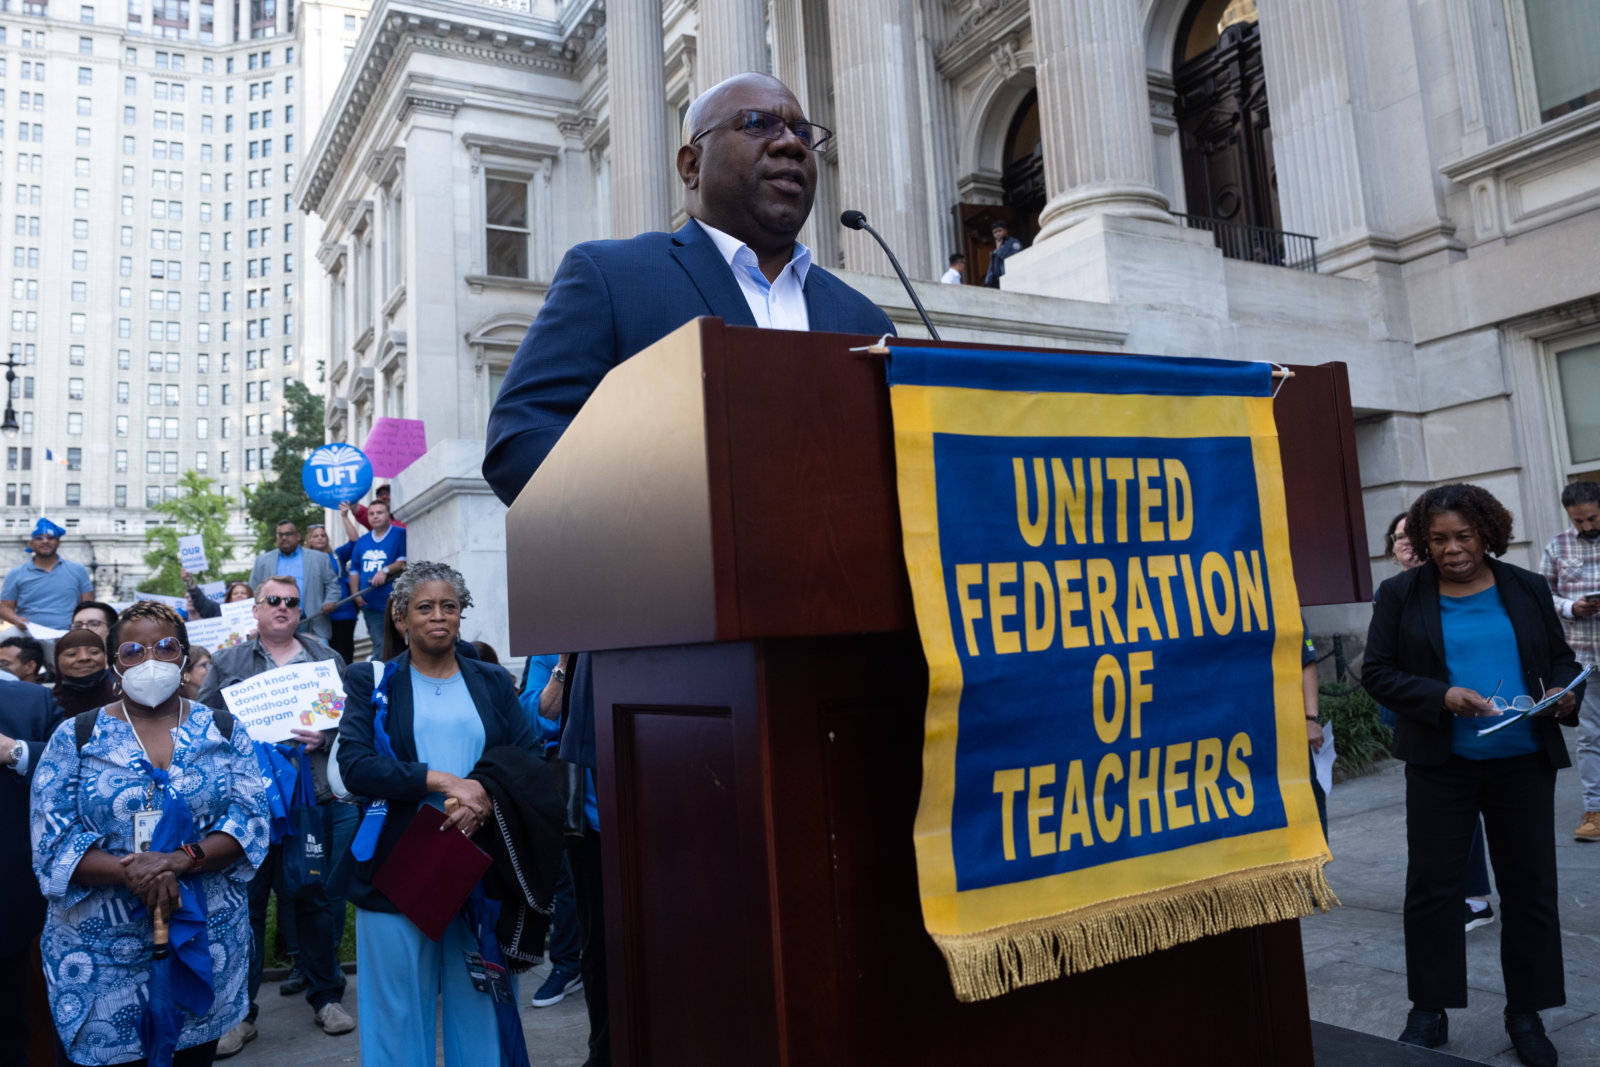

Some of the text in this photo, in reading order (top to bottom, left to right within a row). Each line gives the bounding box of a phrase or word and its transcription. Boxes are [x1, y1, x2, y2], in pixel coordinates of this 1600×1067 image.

[315, 464, 359, 488] UFT
[1012, 457, 1194, 547] UNITED
[363, 560, 385, 573] UFT
[955, 549, 1269, 657] FEDERATION
[230, 671, 300, 697] Don't knock
[234, 680, 320, 706] down our early
[1092, 650, 1154, 744] OF
[238, 695, 298, 717] childhood
[993, 732, 1254, 861] TEACHERS
